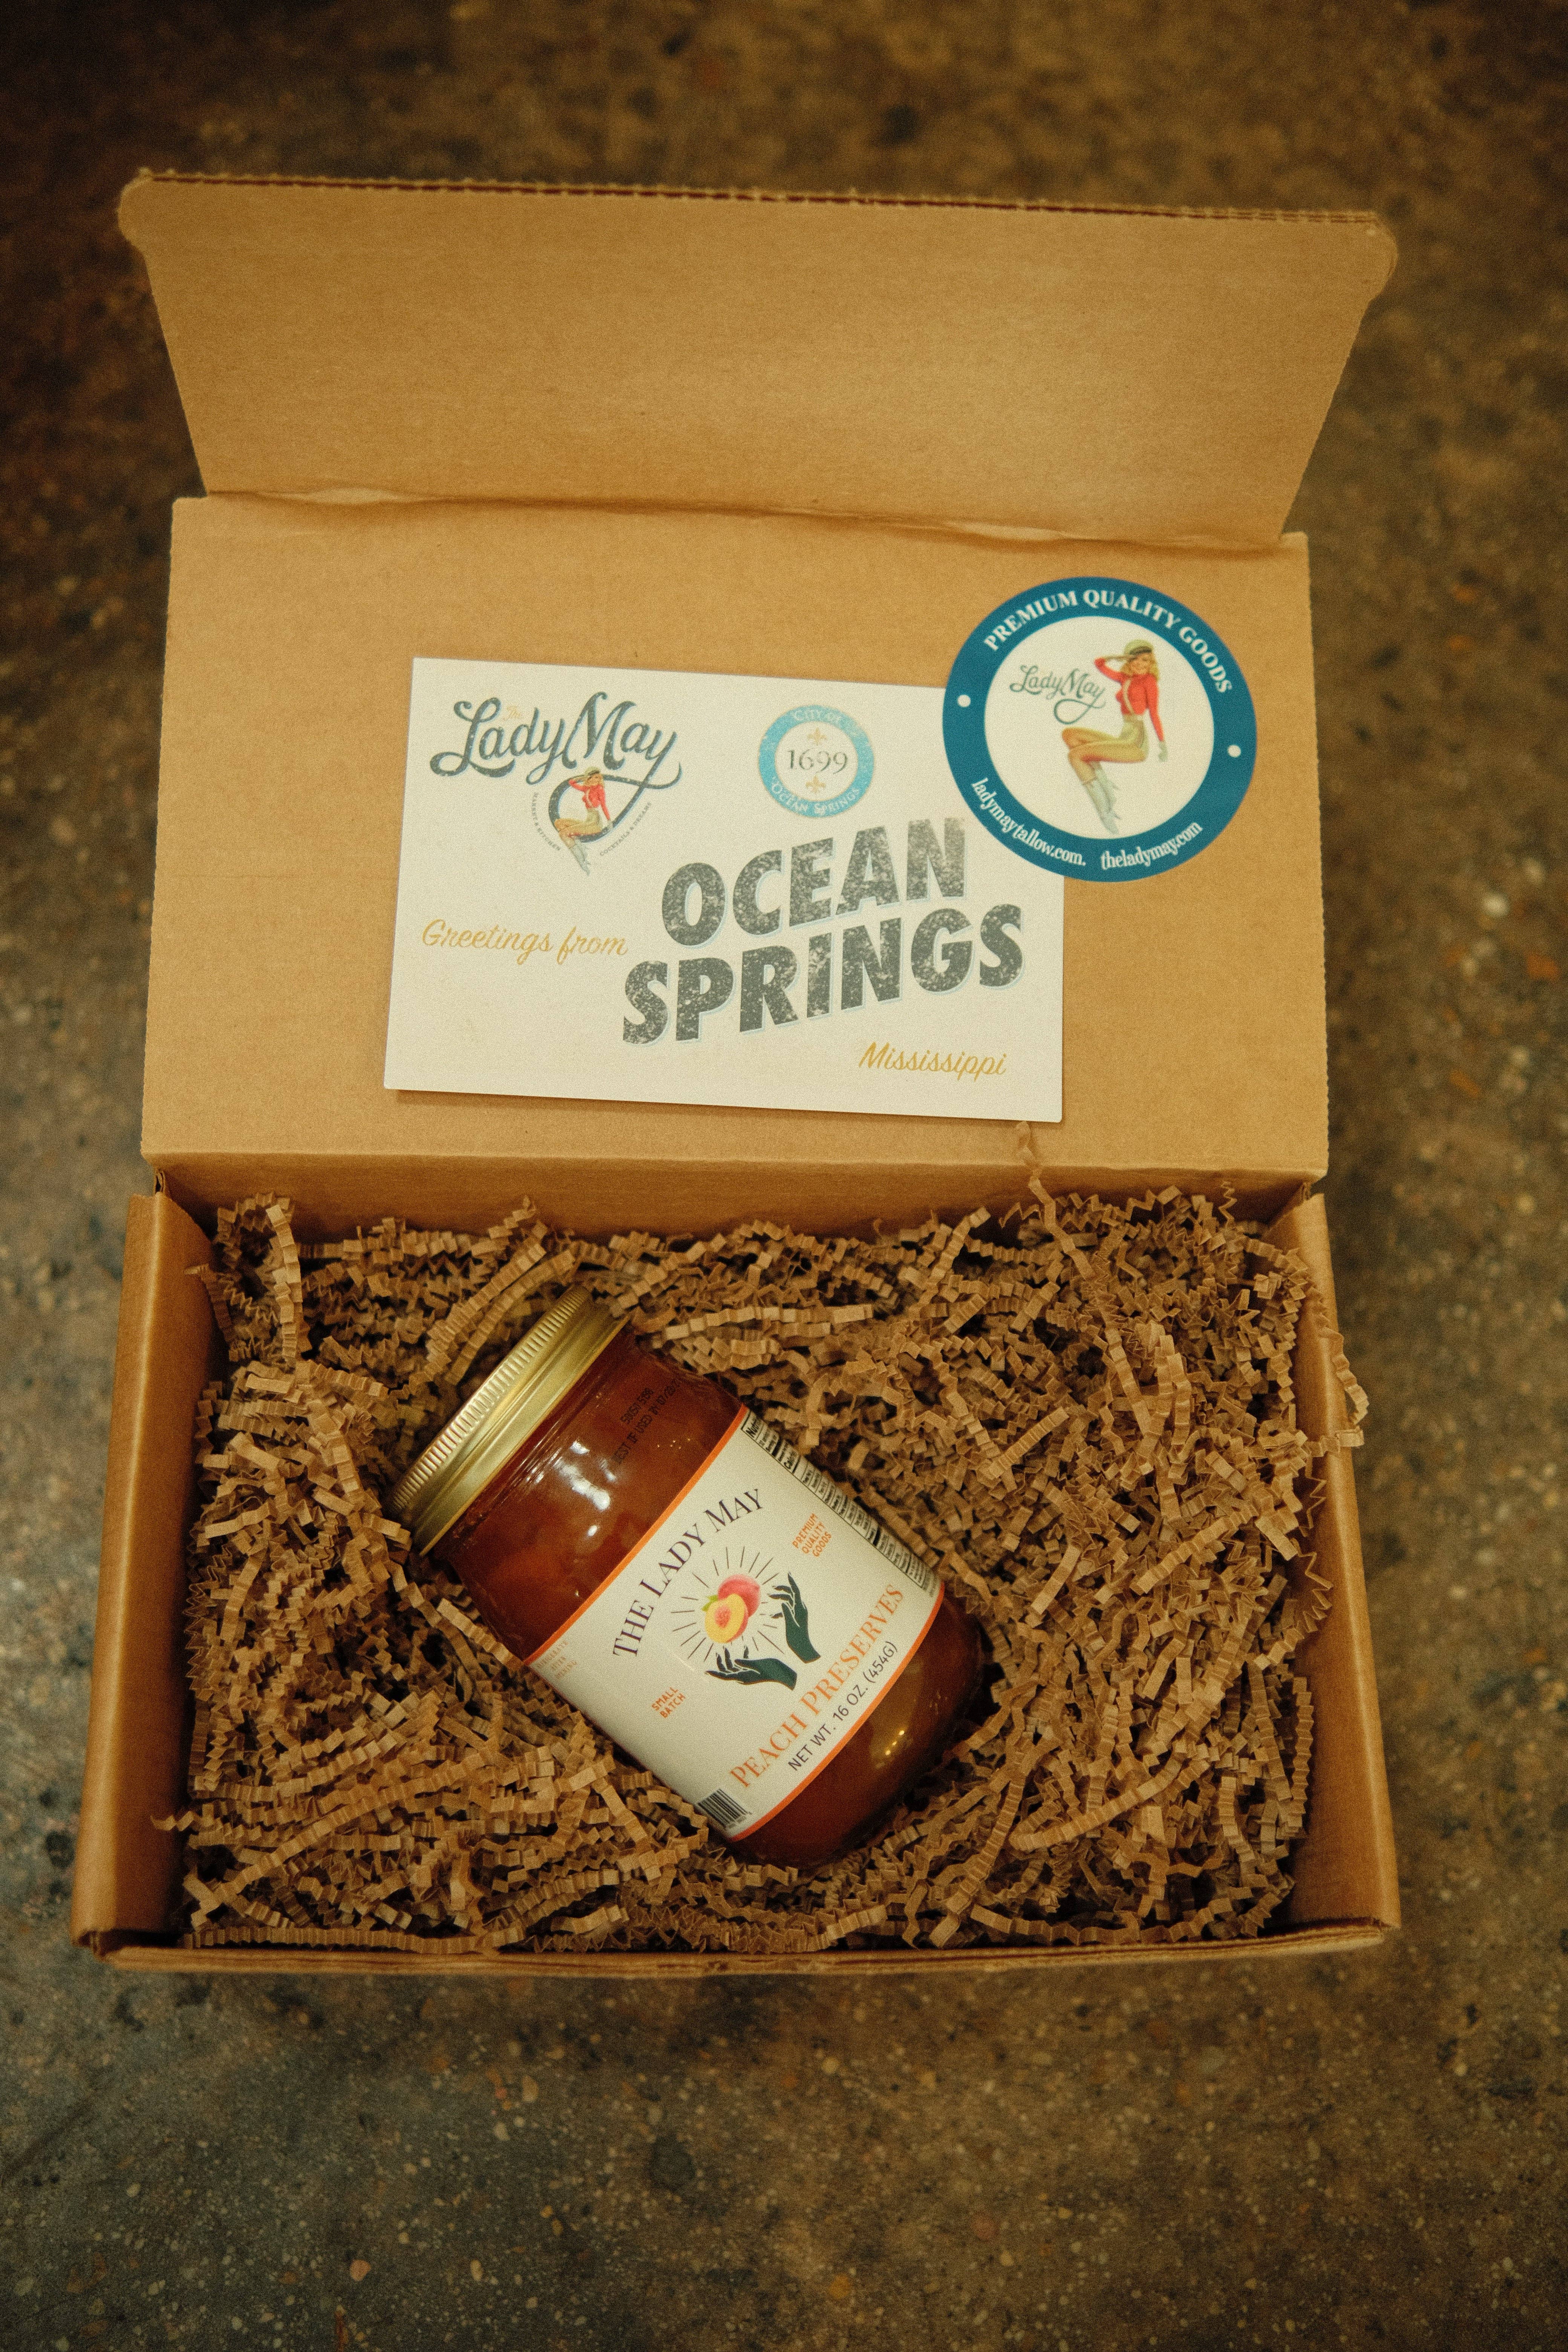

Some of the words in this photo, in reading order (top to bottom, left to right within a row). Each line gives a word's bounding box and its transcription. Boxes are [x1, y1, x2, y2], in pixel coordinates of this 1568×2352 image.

[983, 590, 1079, 652] PREMIUM
[1083, 589, 1182, 630] QUALITY
[1178, 625, 1233, 694] GOODS
[1009, 665, 1062, 700] Lady
[429, 697, 565, 785] Lady
[787, 748, 848, 775] 1699
[1101, 821, 1203, 870] theladymay.com
[662, 817, 966, 947] OCEAN
[422, 919, 553, 966] Greetings
[557, 926, 628, 965] from
[622, 903, 1023, 1045] SPRINGS
[858, 1041, 1006, 1082] Mississippi
[634, 1415, 653, 1433] USED
[792, 1513, 818, 1548] PREMIUM
[802, 1522, 825, 1554] QUALITY
[812, 1531, 831, 1557] GOODS
[613, 1600, 655, 1657] THE
[639, 1523, 705, 1597] LADY
[704, 1488, 763, 1533] MAY
[651, 1686, 678, 1711] SMALL
[660, 1693, 686, 1718] BATCH
[729, 1713, 808, 1788] PEACH
[799, 1583, 904, 1715] PRESERVES
[787, 1746, 813, 1771] NET
[811, 1724, 836, 1747] WT.
[833, 1706, 850, 1722] 16
[847, 1685, 868, 1705] OZ.
[864, 1641, 898, 1683] (454G)
